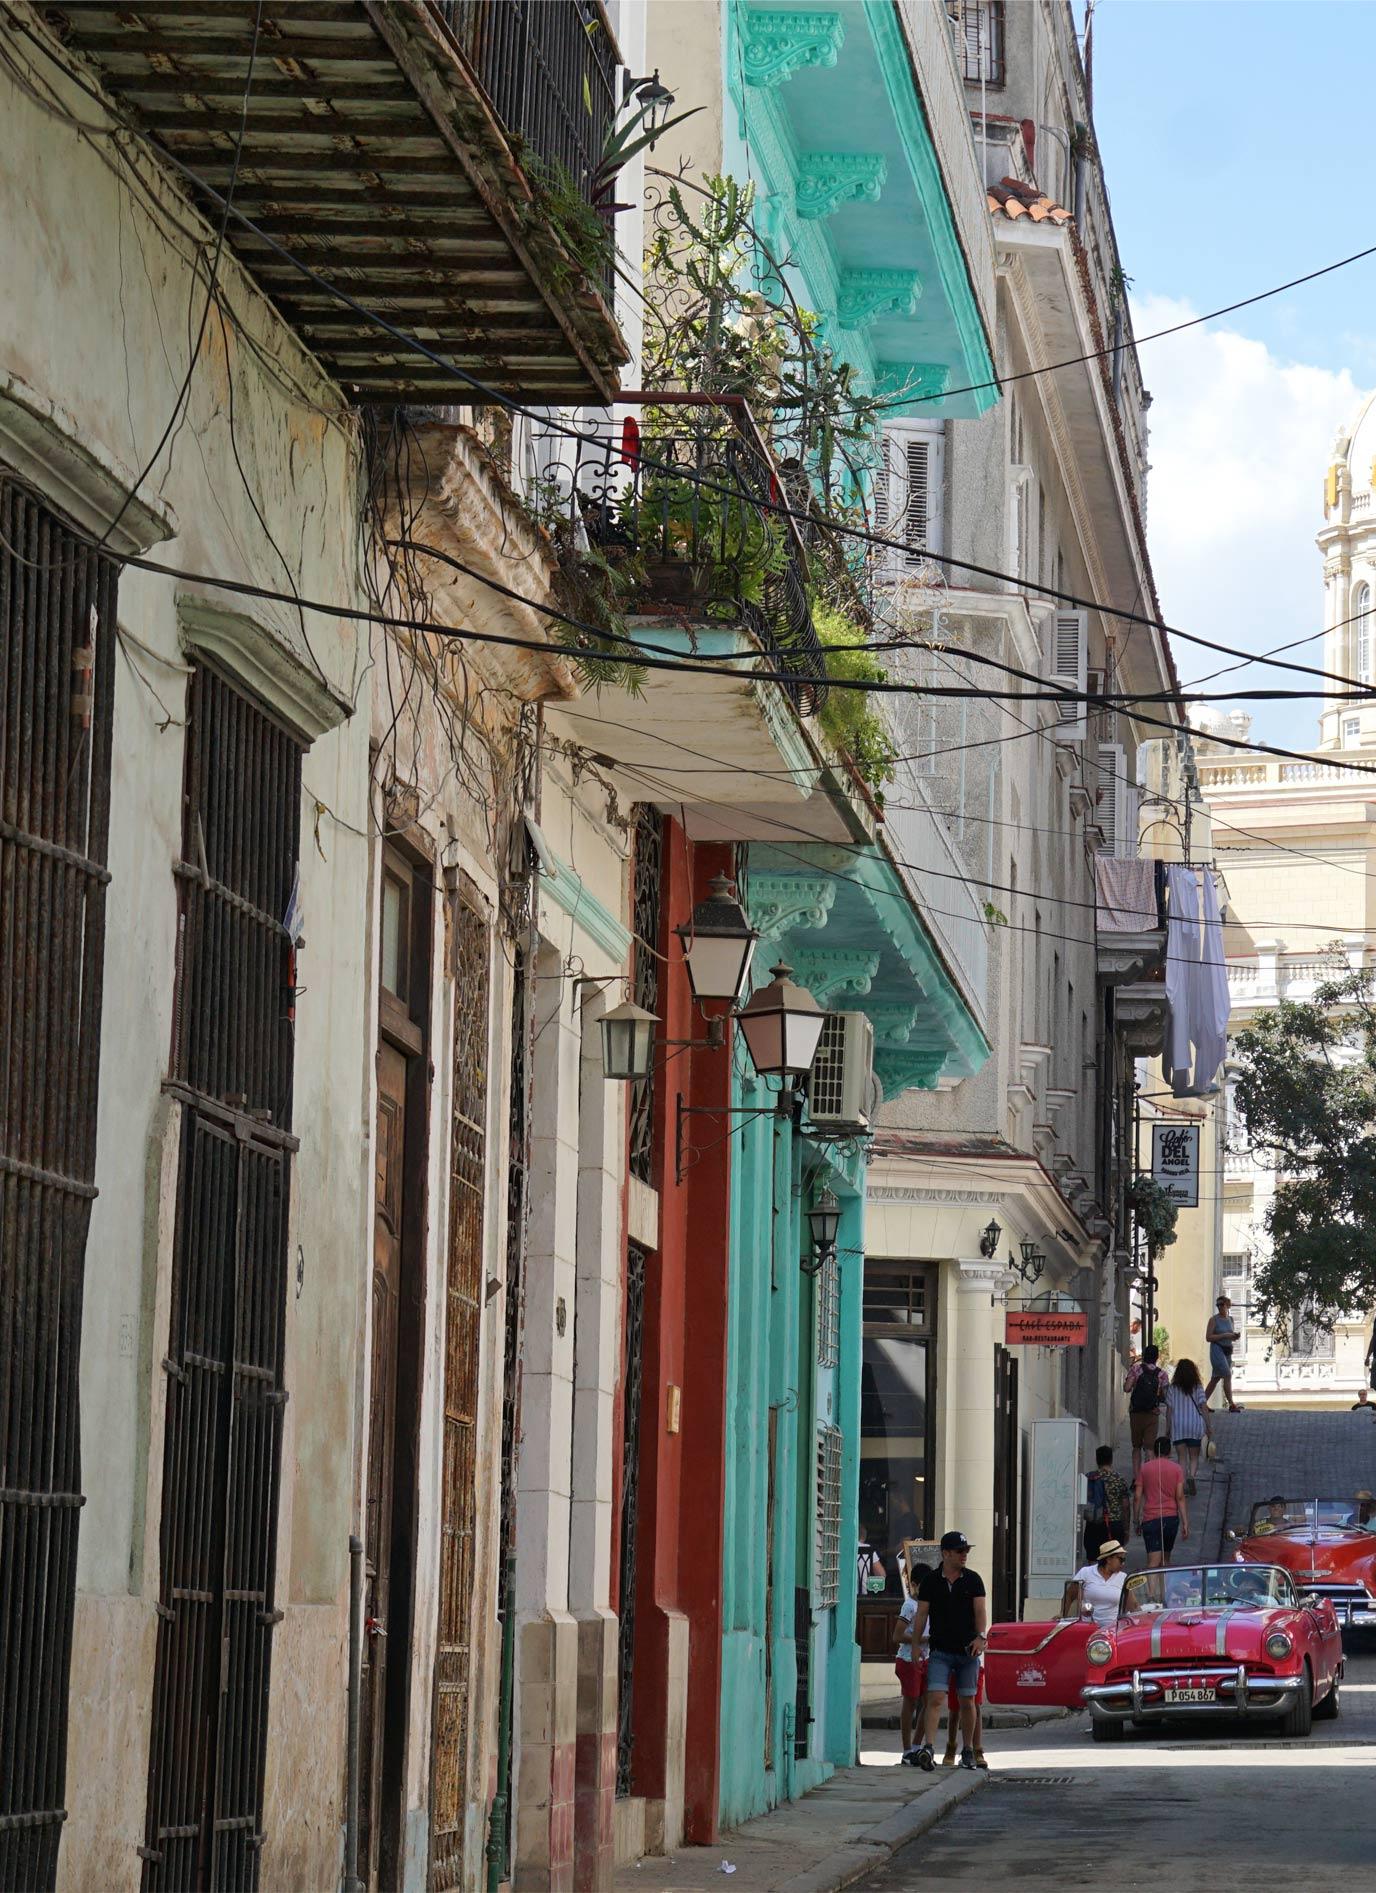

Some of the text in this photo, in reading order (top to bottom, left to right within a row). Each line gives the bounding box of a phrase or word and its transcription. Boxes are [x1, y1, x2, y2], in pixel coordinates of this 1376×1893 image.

[1159, 1129, 1192, 1147] Café
[1162, 1145, 1190, 1158] DEL
[1020, 1319, 1080, 1331] CAFÉ ESPADA
[1198, 1690, 1214, 1700] 867
